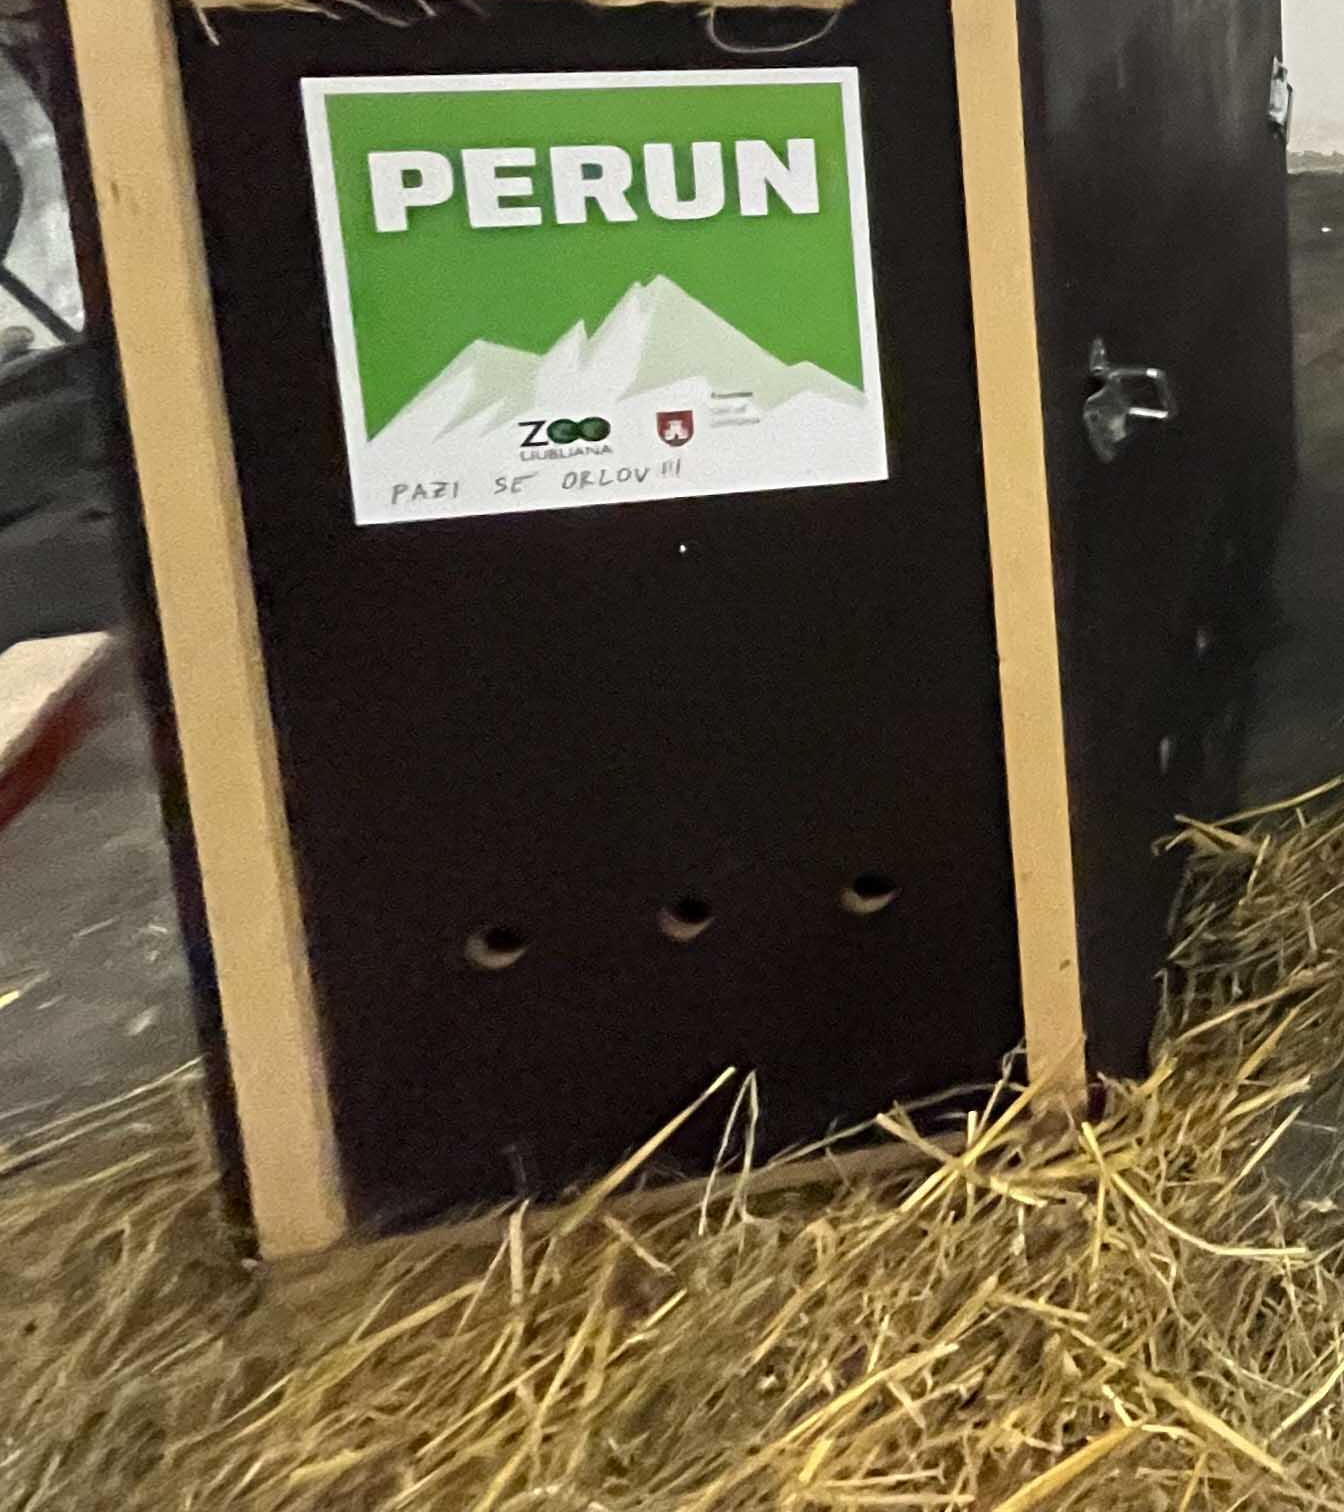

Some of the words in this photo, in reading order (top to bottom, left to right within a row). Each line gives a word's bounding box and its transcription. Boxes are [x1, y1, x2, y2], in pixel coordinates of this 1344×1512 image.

[367, 138, 820, 233] PERUN
[518, 416, 611, 448] ZOO
[391, 482, 459, 505] PAZI
[494, 471, 538, 494] SE
